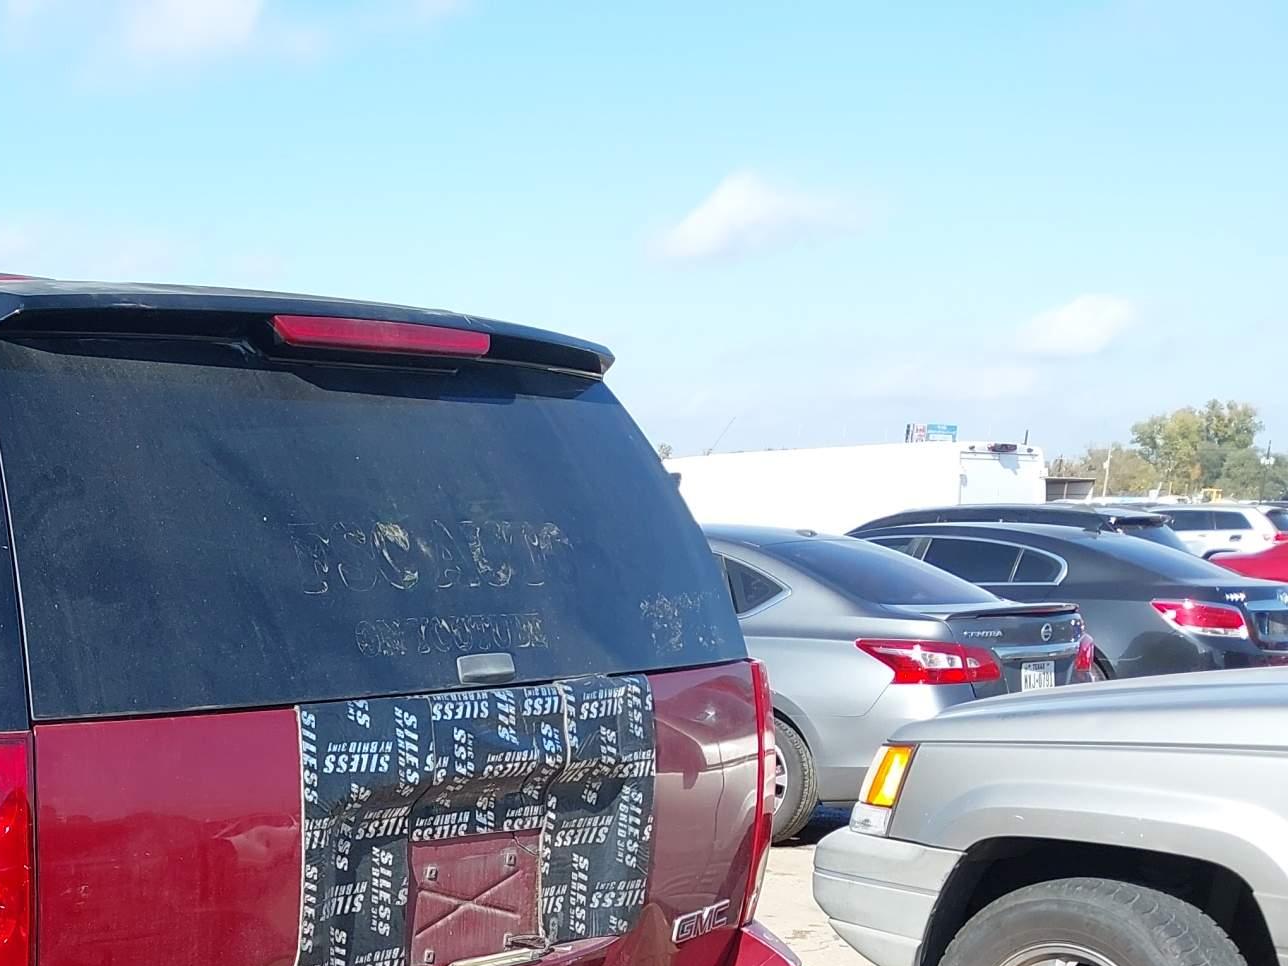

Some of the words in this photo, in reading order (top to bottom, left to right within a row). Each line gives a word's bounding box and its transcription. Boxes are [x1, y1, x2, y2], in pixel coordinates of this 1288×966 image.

[432, 701, 489, 721] SILESS
[579, 698, 624, 720] SILESS
[301, 711, 318, 805] SILESS
[348, 741, 393, 753] HYBRID
[322, 753, 391, 774] SILESS
[577, 815, 614, 828] HYBRID
[625, 791, 643, 869] SILESS
[554, 827, 609, 848] SILESS
[377, 849, 393, 937] SILESS
[575, 855, 590, 936] SILESS
[671, 898, 731, 944] GMC
